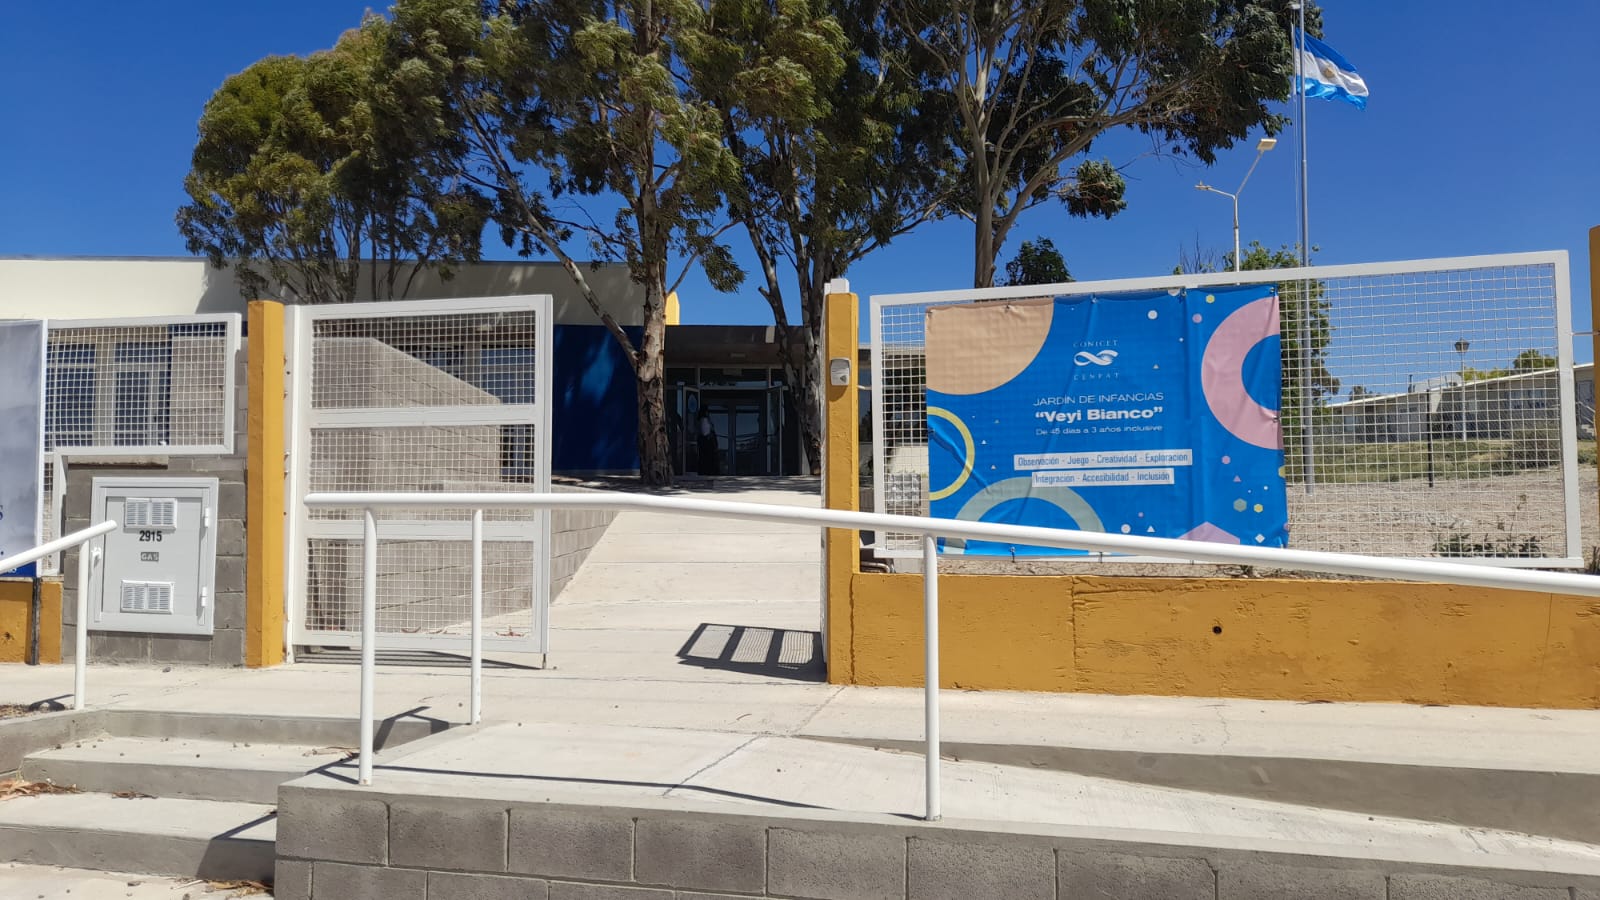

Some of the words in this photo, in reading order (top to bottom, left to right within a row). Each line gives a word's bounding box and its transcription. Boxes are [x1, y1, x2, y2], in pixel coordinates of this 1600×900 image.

[1073, 339, 1119, 348] CONICET
[1079, 395, 1096, 404] DE
[1098, 392, 1164, 403] INFANCIAS
[1036, 428, 1048, 436] De
[1091, 426, 1097, 434] 3
[1099, 426, 1122, 434] años
[1124, 424, 1163, 433] inclusive
[1067, 455, 1089, 466] Juego
[1096, 454, 1137, 464] Creatividad
[1082, 471, 1129, 482] Accesibilidad
[139, 530, 162, 542] 2915
